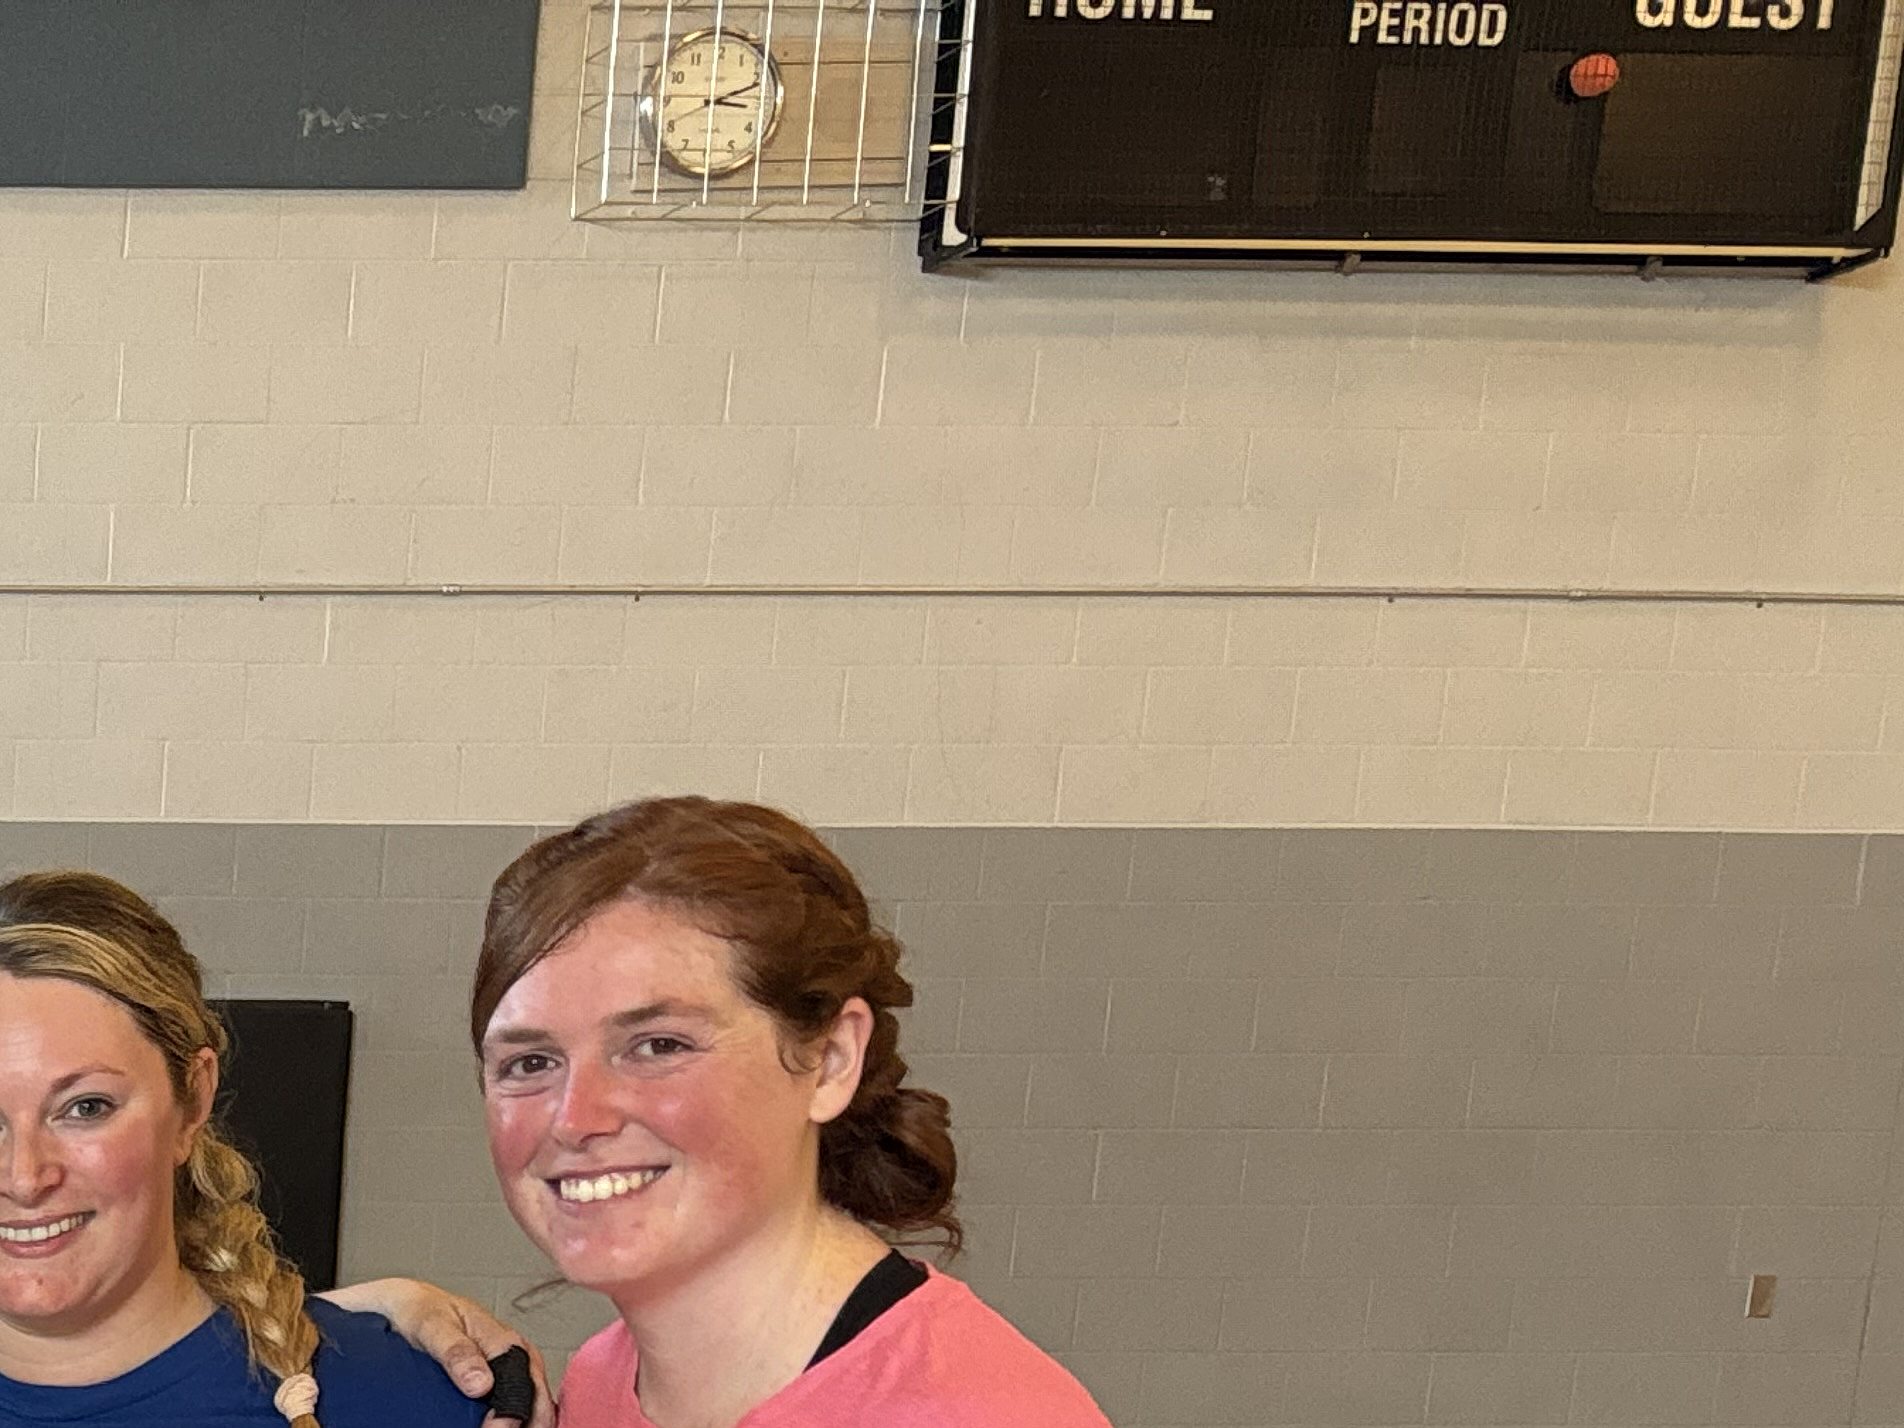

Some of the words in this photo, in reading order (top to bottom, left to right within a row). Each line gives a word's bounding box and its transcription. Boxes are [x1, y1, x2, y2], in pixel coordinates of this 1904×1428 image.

[1348, 1, 1508, 46] PERIOD
[671, 70, 685, 85] 10
[666, 119, 676, 134] 8
[743, 121, 753, 134] 4
